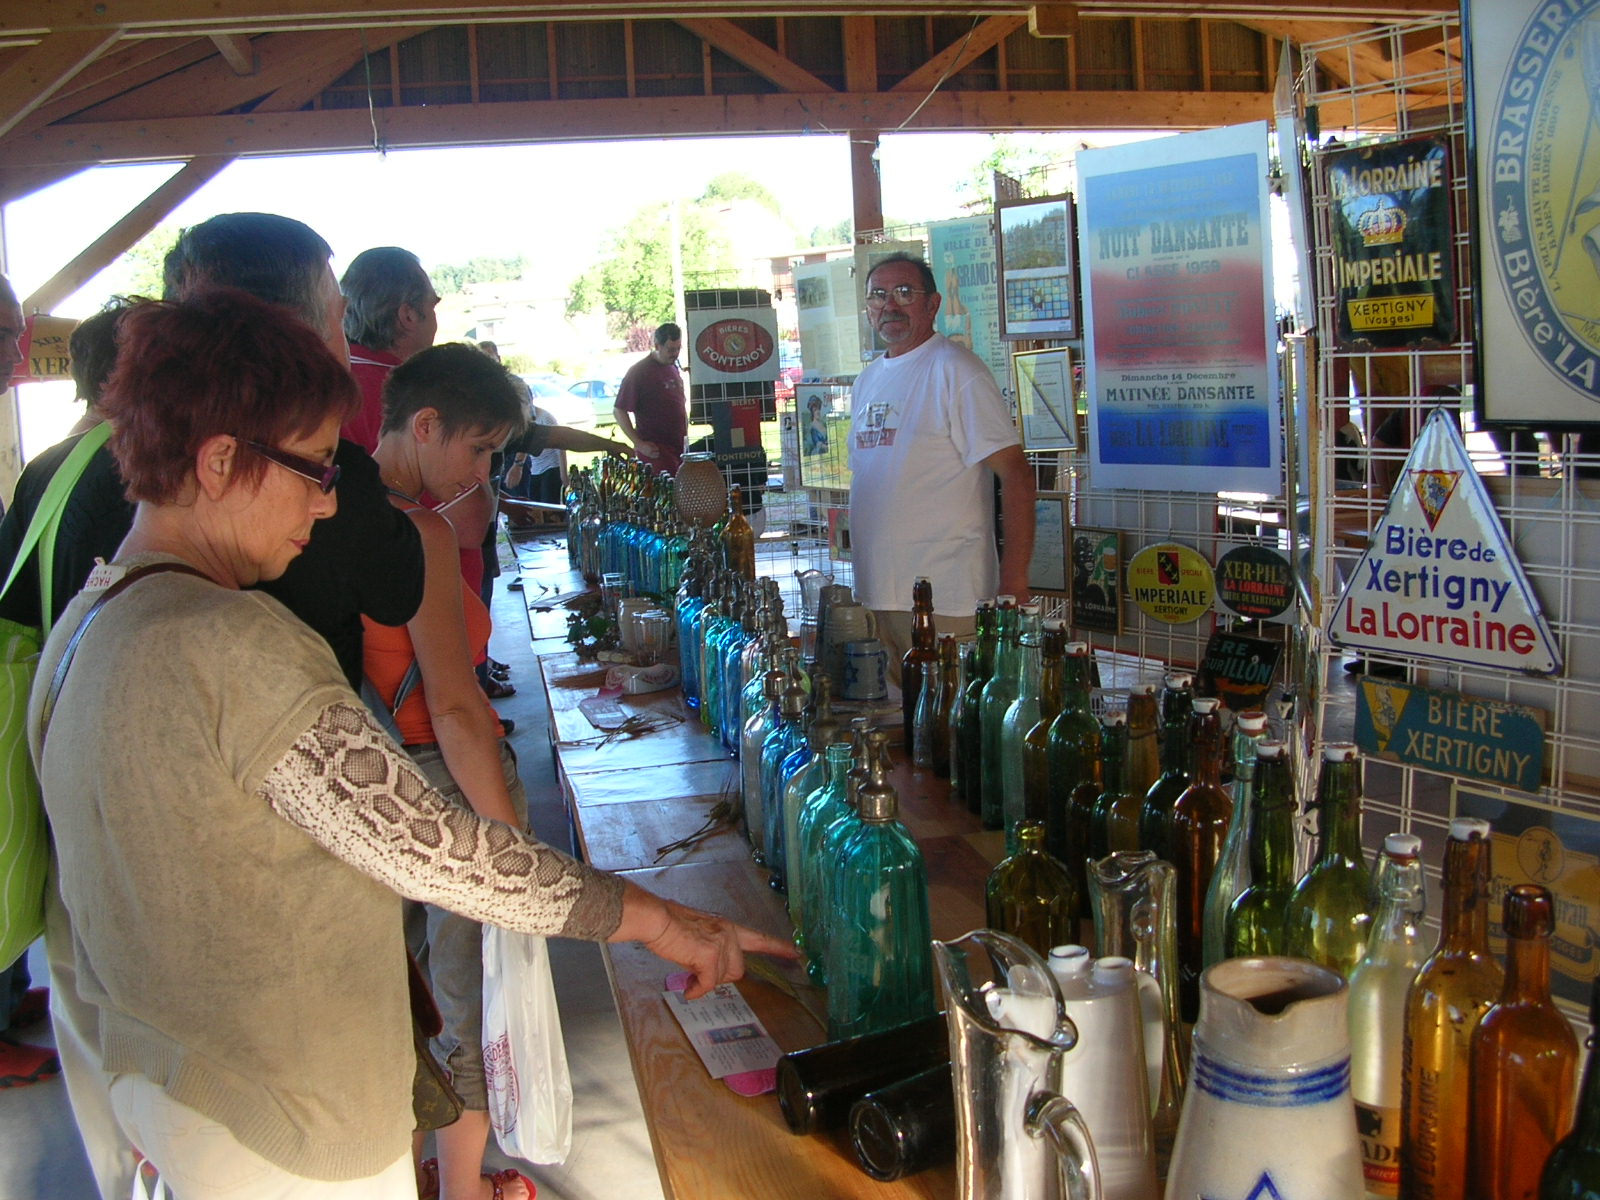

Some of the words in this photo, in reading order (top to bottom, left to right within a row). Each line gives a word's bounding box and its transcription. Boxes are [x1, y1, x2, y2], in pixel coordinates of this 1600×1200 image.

[1496, 0, 1586, 183] BRASSERI
[1531, 176, 1544, 228] HAUTE
[1098, 224, 1141, 261] NUIT
[1150, 211, 1249, 255] DANSANTE
[1542, 199, 1558, 249] BADEN
[1536, 232, 1553, 268] PLUS
[1353, 299, 1427, 317] XERTIGNY
[703, 344, 766, 368] FONTENOY
[1106, 385, 1171, 402] MATINÉE
[1177, 385, 1256, 400] DANSANTE
[1121, 373, 1169, 382] Dimanche
[1171, 373, 1183, 381] 14
[717, 450, 763, 462] FONTENOY
[1386, 525, 1467, 561] Bière
[1469, 541, 1497, 563] de
[1135, 588, 1207, 606] IMPERIALE
[1223, 579, 1237, 591] LA
[1239, 580, 1287, 597] LORRAINE
[1366, 558, 1512, 613] Xertigny
[1346, 597, 1377, 636] La
[1382, 602, 1536, 655] Lorraine
[1405, 728, 1532, 783] XERTIGNY
